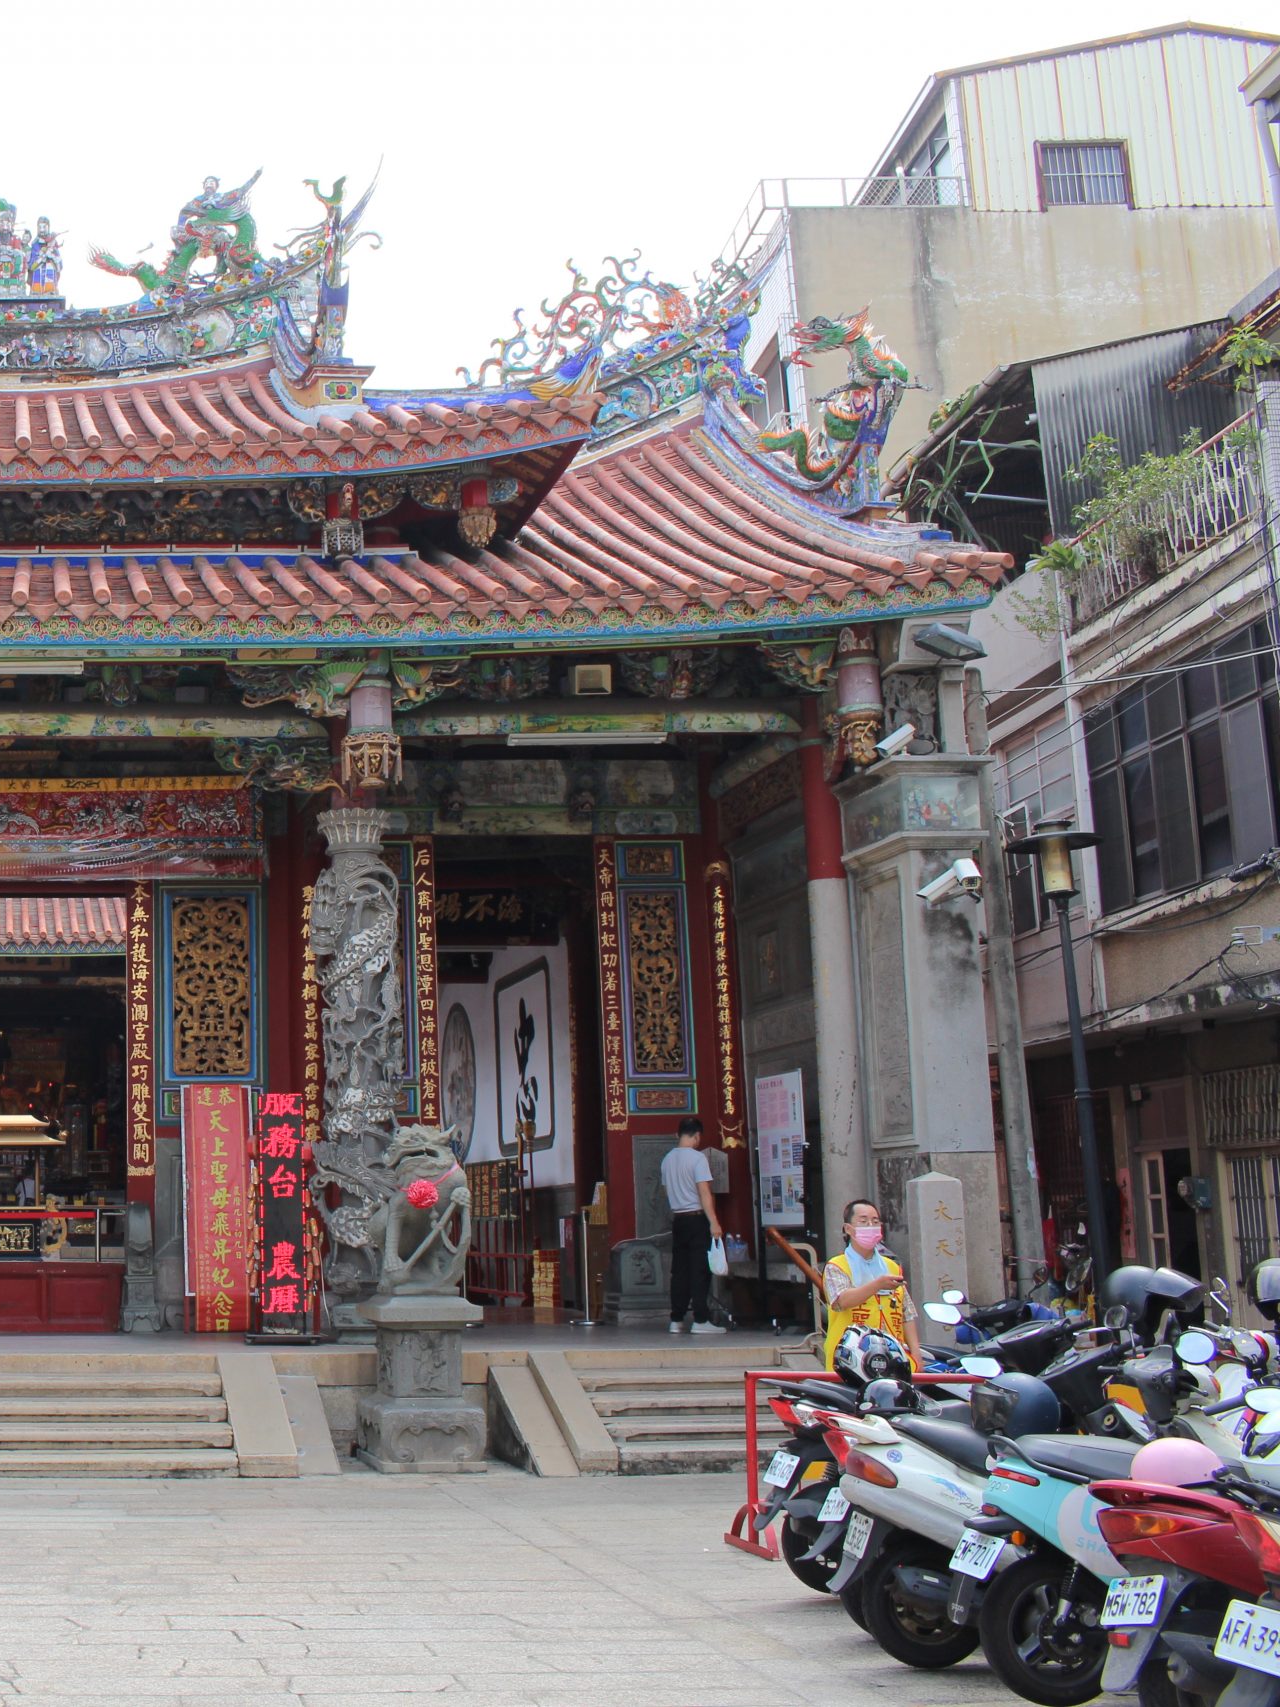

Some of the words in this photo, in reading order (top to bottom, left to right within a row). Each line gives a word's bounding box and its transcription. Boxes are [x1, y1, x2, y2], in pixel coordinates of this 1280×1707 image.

[197, 1087, 236, 1107] 恭逢
[262, 1093, 302, 1198] 服務台
[208, 1109, 235, 1332] 天上聖母飛昇紀念日
[954, 1539, 997, 1569] EMF-7211
